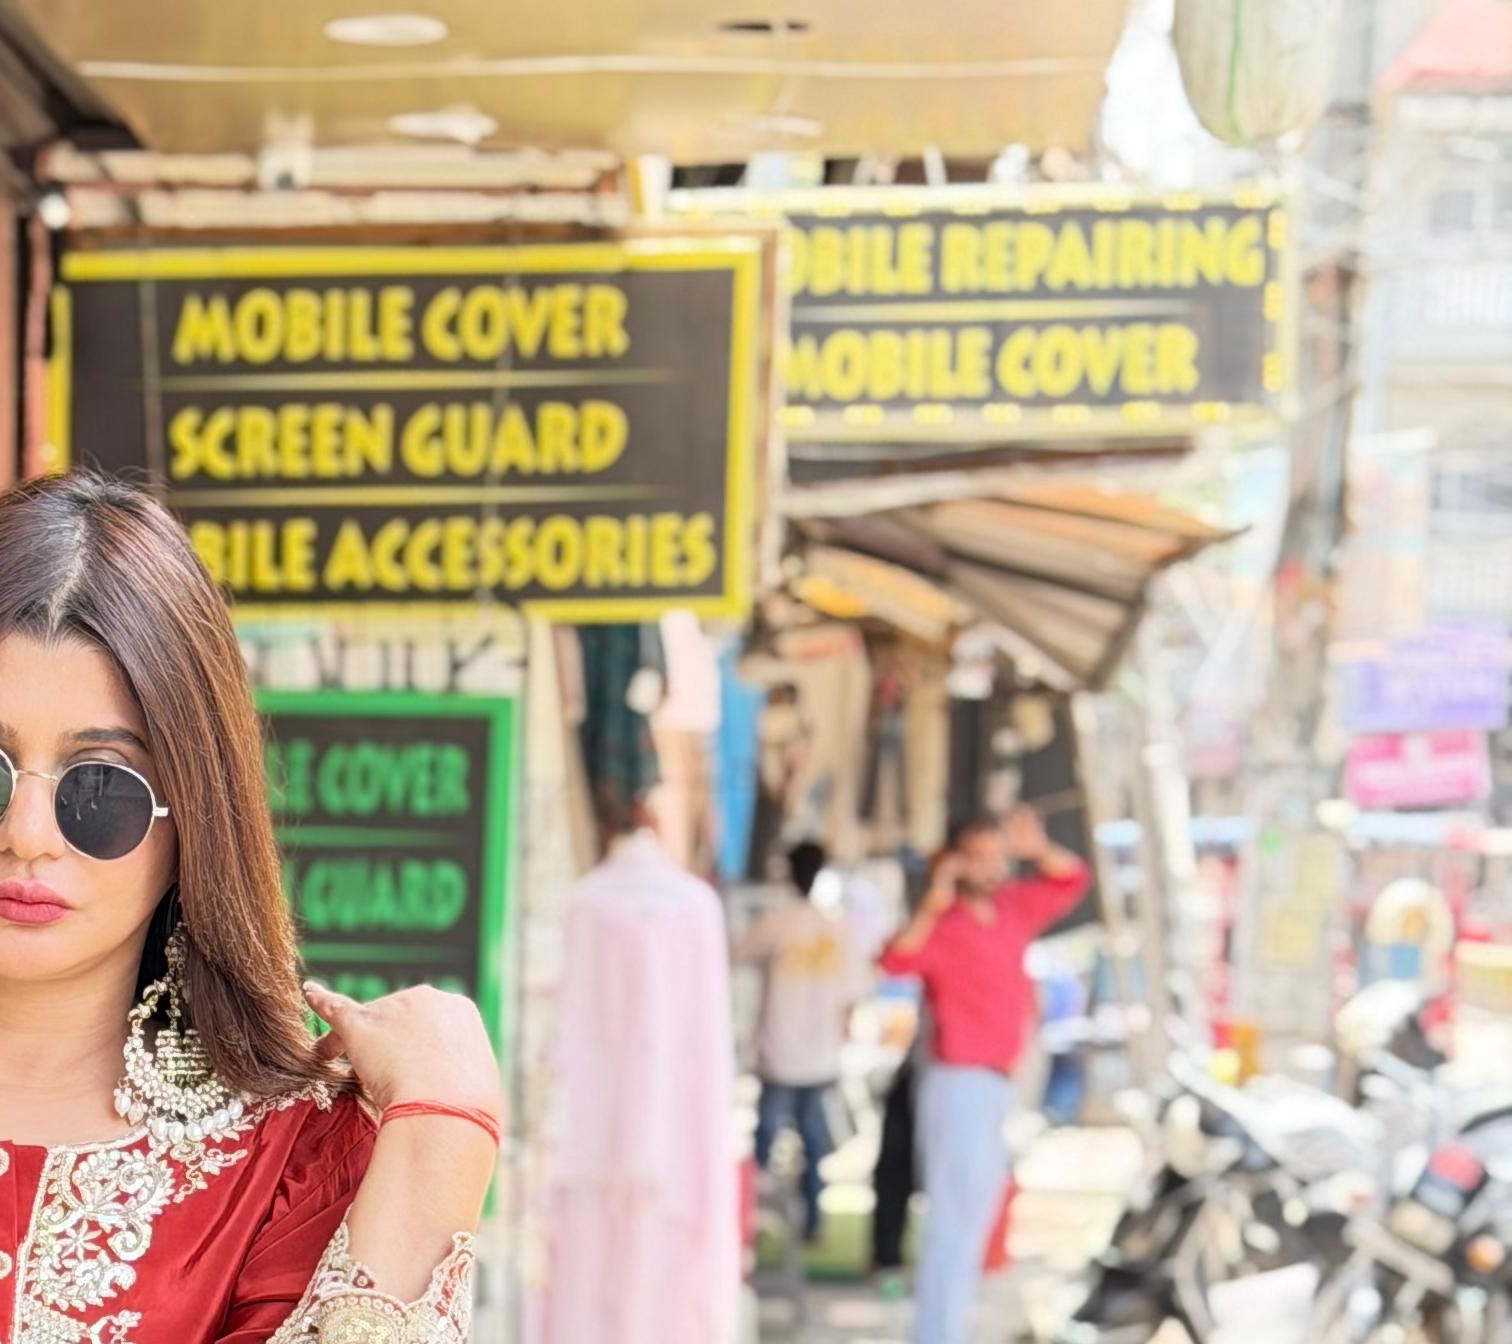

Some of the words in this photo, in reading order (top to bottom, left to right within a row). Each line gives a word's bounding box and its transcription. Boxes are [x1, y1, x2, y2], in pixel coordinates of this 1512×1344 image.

[785, 225, 932, 296] BILE
[940, 216, 1264, 292] REPAIRING
[173, 286, 412, 363] MOBILE
[422, 283, 628, 360] COVER
[996, 325, 1199, 397] COVER
[169, 404, 393, 479] SCREEN
[400, 401, 628, 478] GUARD
[189, 519, 317, 592] BILE
[322, 513, 717, 592] ACCESSORIES
[317, 743, 470, 815] COVER
[301, 860, 468, 929] GUARD
